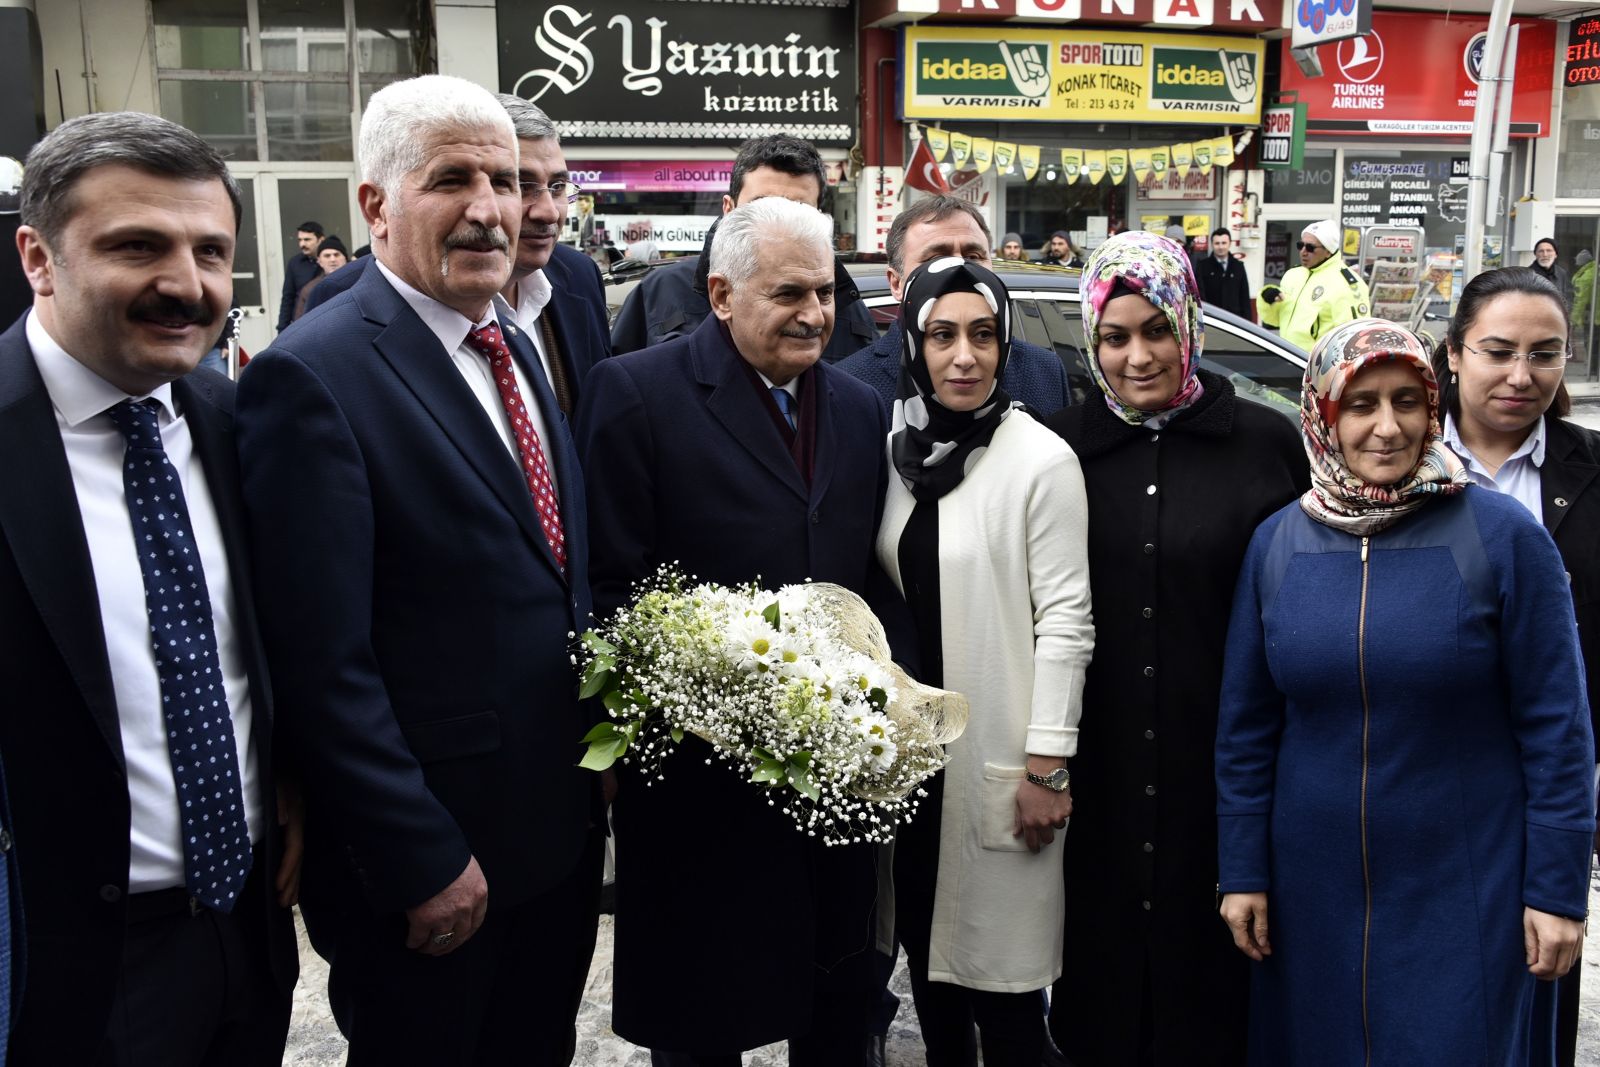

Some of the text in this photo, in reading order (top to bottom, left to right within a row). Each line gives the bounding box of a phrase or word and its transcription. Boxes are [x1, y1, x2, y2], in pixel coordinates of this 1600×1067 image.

[1327, 19, 1354, 34] 6/49
[607, 14, 841, 96] Yasmin
[922, 58, 1007, 80] iddaa
[1157, 64, 1225, 86] iddaa
[1057, 70, 1143, 98] KONAK TİCARET
[1333, 84, 1384, 97] TURKISH
[703, 86, 839, 112] kozmetik
[942, 97, 1042, 108] VARMISIN
[1065, 98, 1079, 109] Tel
[1089, 99, 1104, 110] 213
[1108, 100, 1121, 110] 43
[1123, 100, 1135, 111] 74
[1332, 97, 1384, 109] AIRLINES
[1162, 101, 1241, 113] VARMISIN
[1264, 113, 1291, 133] SPOR
[1263, 139, 1289, 160] TOTO
[654, 168, 670, 181] all
[674, 168, 716, 181] about
[1344, 180, 1430, 189] GİRESUN KOCAELİ
[1343, 193, 1369, 201] ORDU
[1390, 192, 1434, 202] İSTANBUL
[1343, 205, 1428, 214] SAMSUN ANKARA
[1389, 217, 1420, 226] BURSA
[618, 225, 664, 241] İNDİRİM
